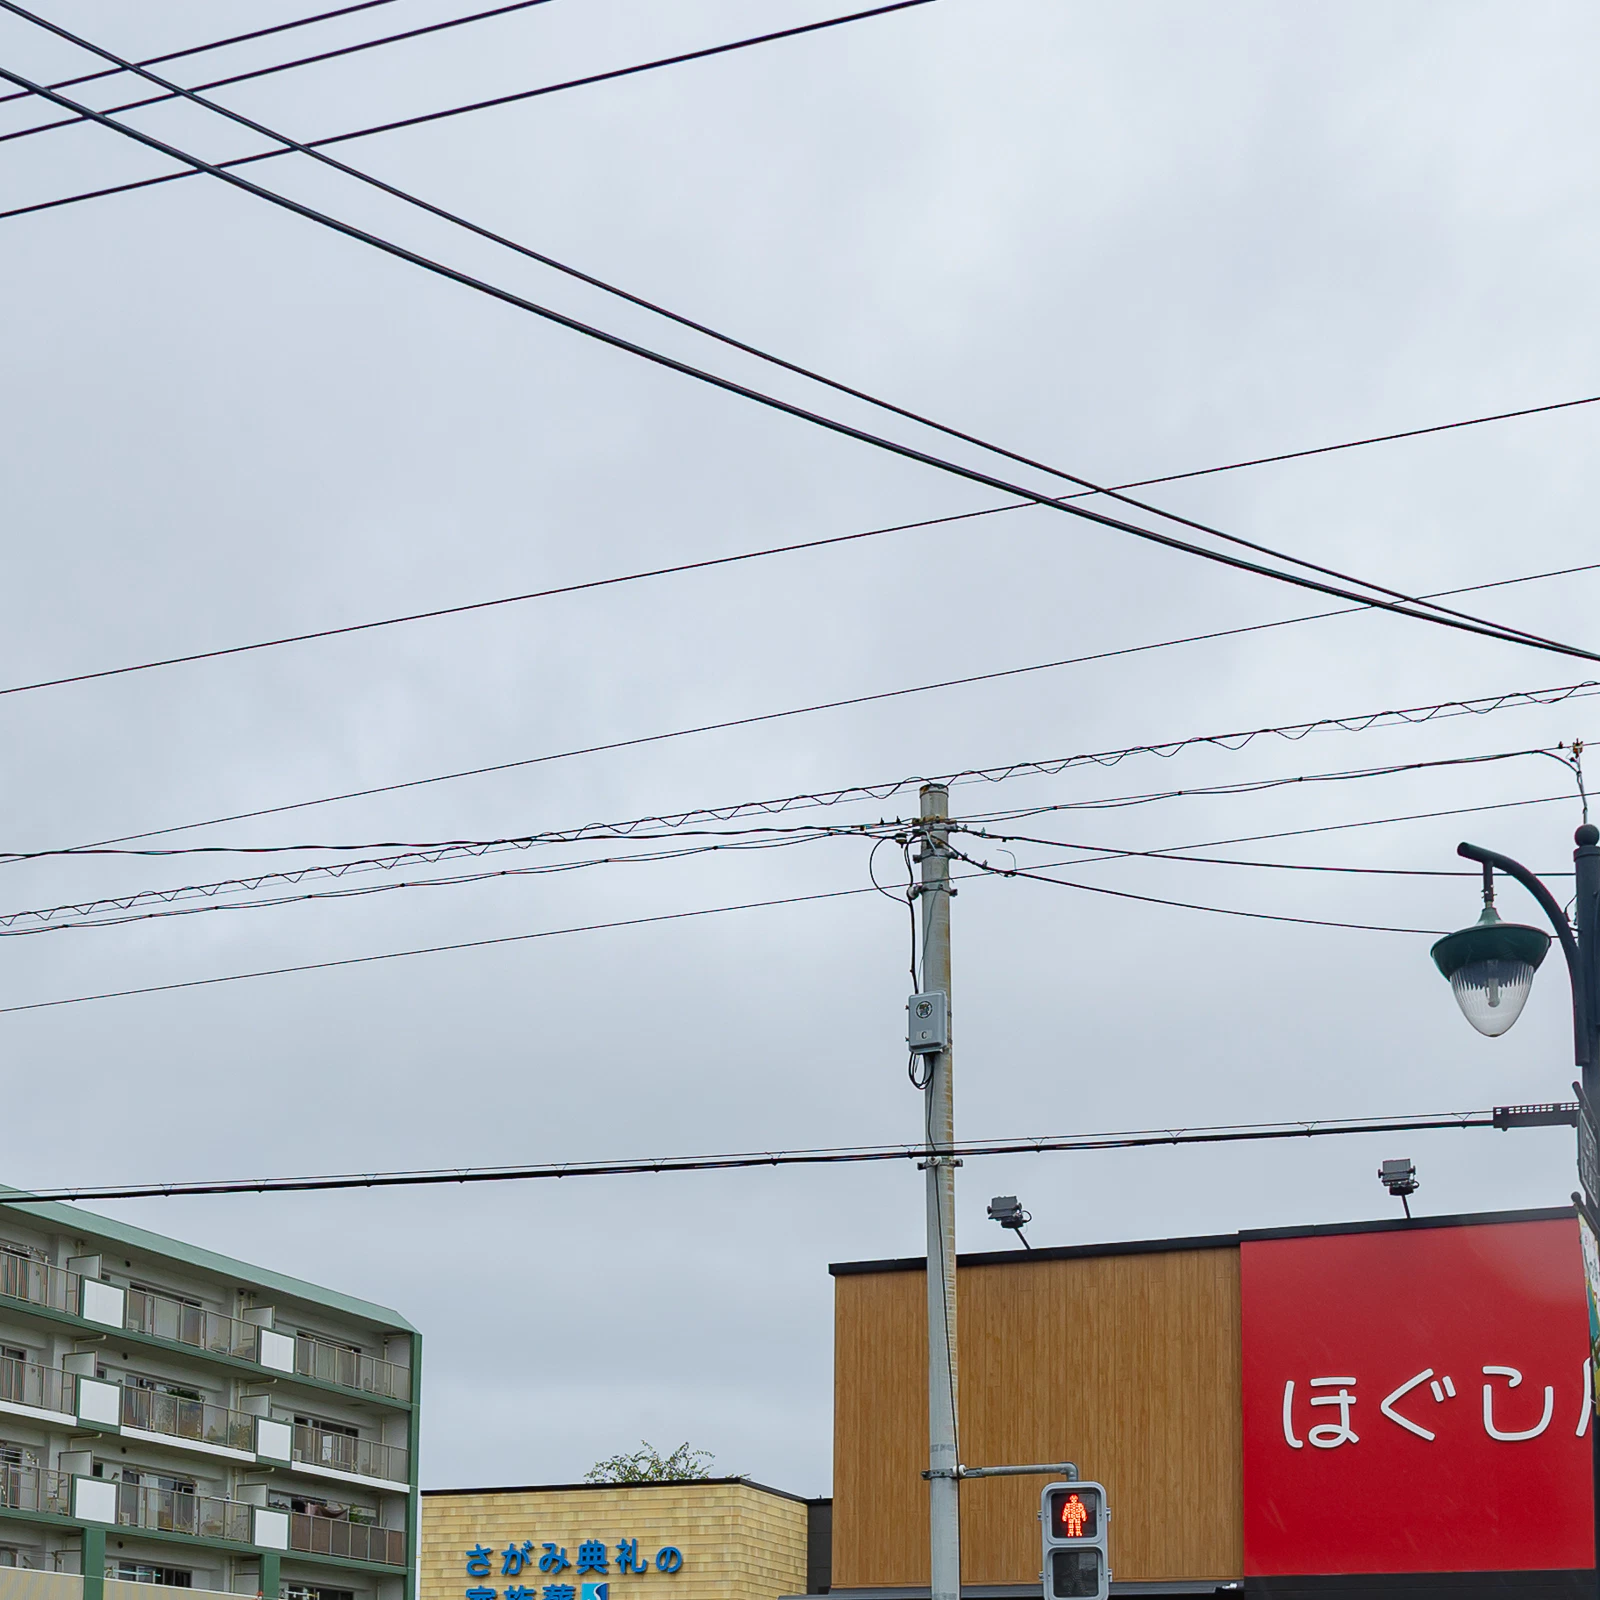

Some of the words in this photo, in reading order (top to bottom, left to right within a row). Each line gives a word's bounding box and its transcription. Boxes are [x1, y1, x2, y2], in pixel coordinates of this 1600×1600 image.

[465, 1538, 684, 1577] さがみ典礼の
